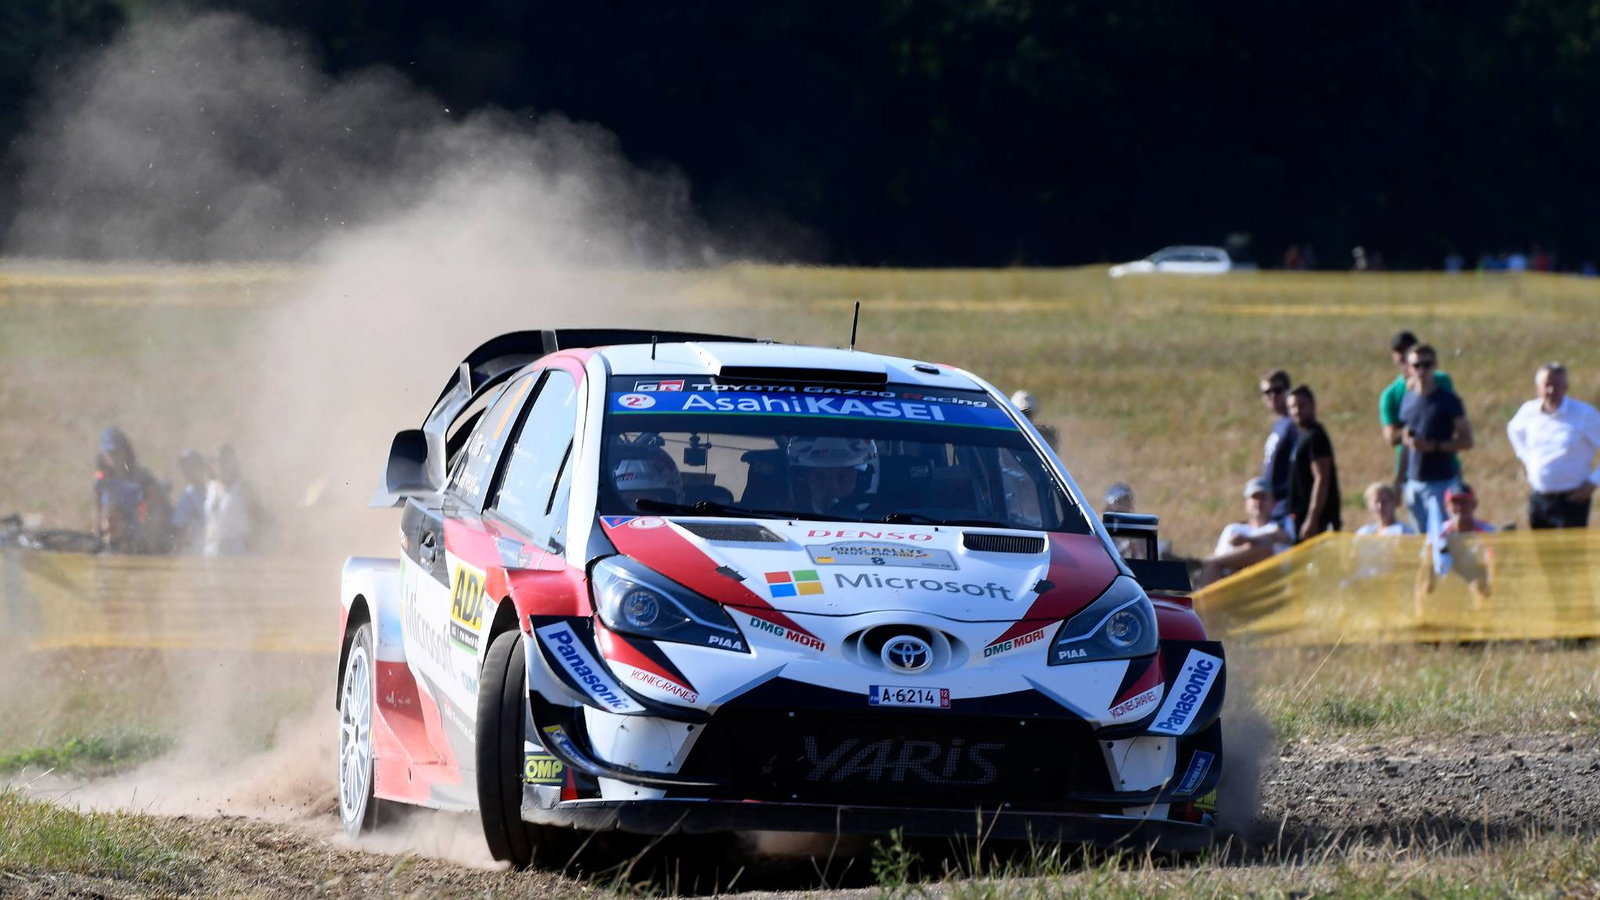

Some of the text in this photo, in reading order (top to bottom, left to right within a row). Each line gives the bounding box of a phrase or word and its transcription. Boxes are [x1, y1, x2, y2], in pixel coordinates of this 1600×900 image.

[691, 383, 796, 392] TOYOTA
[803, 386, 896, 398] GAZOO
[902, 392, 988, 408] Racing
[807, 529, 933, 542] DENSO
[870, 556, 886, 566] 8
[834, 572, 1014, 602] Microsoft
[708, 635, 743, 650] PIAA
[749, 616, 825, 652] DMG MORI
[983, 629, 1045, 659] DMG MORI
[1058, 648, 1088, 660] PIAA
[548, 630, 630, 711] Panasonic
[630, 669, 698, 704] KONECRANES
[1155, 658, 1214, 732] Panasonic
[1109, 690, 1157, 720] KONECRANES
[525, 759, 562, 778] OMP
